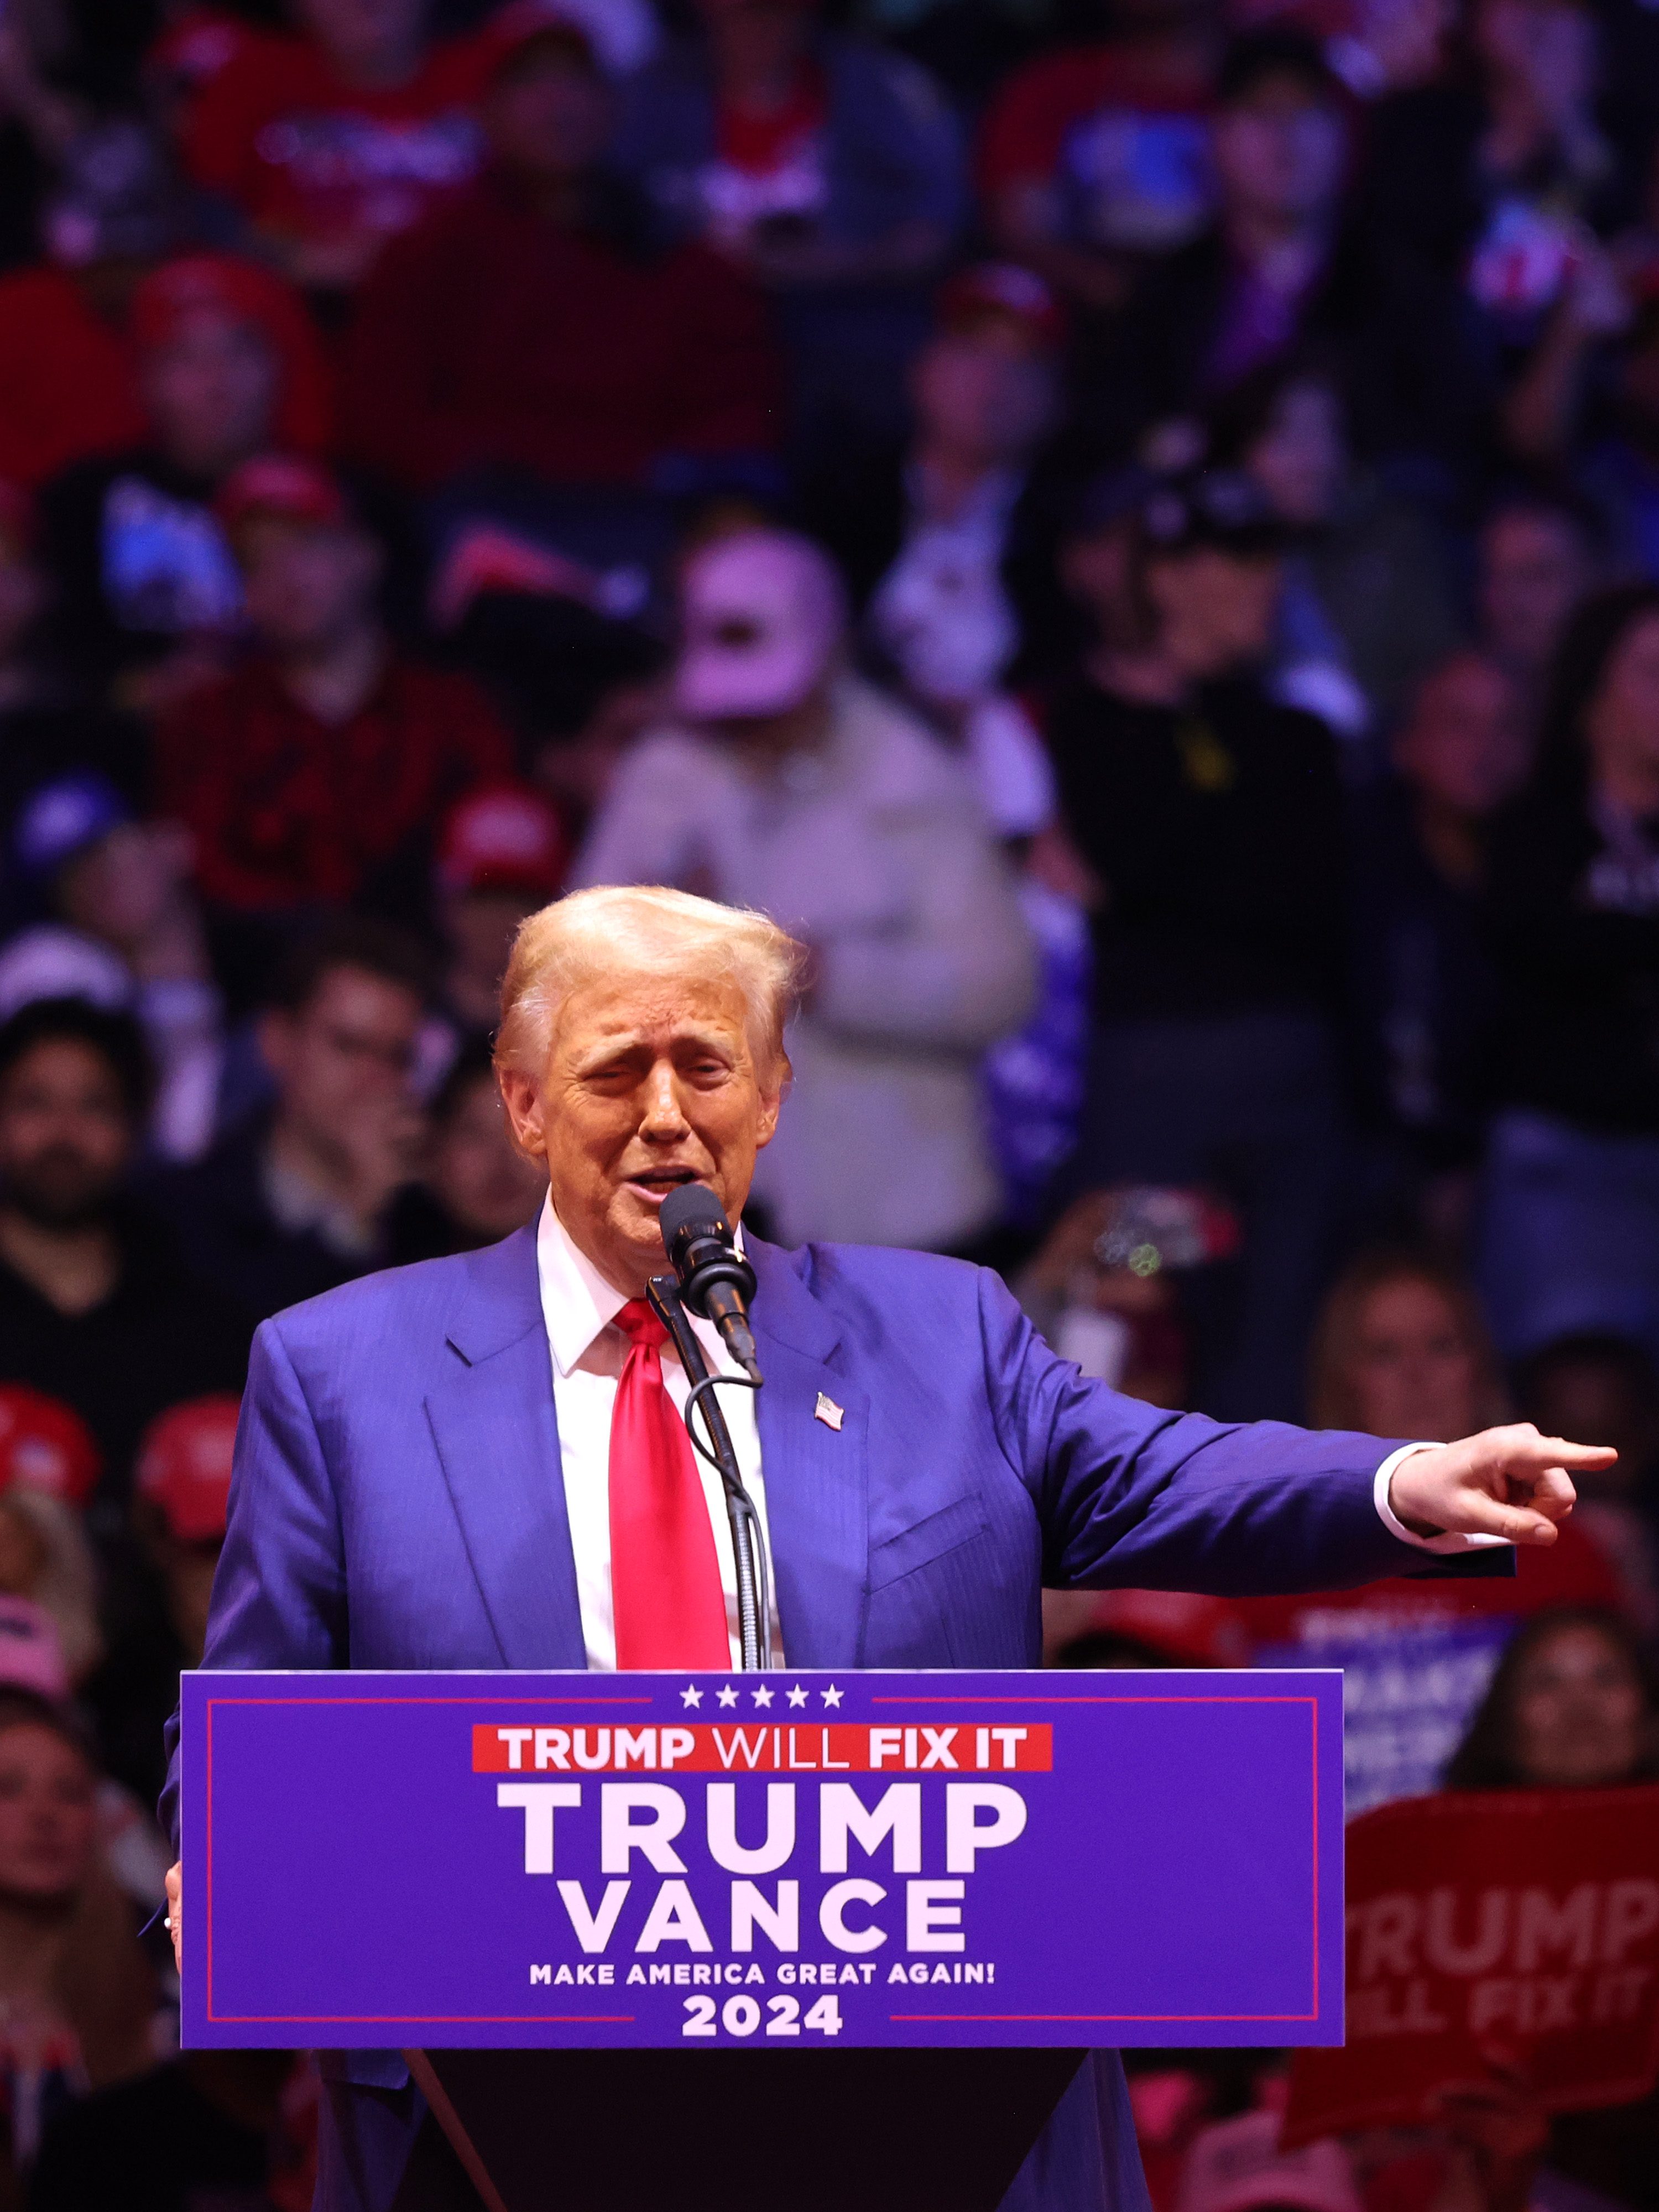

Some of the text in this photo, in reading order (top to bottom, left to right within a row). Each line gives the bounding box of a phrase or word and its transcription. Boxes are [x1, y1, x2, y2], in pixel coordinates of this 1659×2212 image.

[498, 1728, 1027, 1770] TRUMP WILL FIX IT
[497, 1783, 1027, 1874] TRUMP
[557, 1879, 965, 1953] VANCE
[530, 1963, 994, 1985] MAKE AMERICA GREAT AGAIN!
[1467, 1974, 1583, 2036] FIX
[1592, 1962, 1653, 2023] IT
[682, 1995, 843, 2036] 2024
